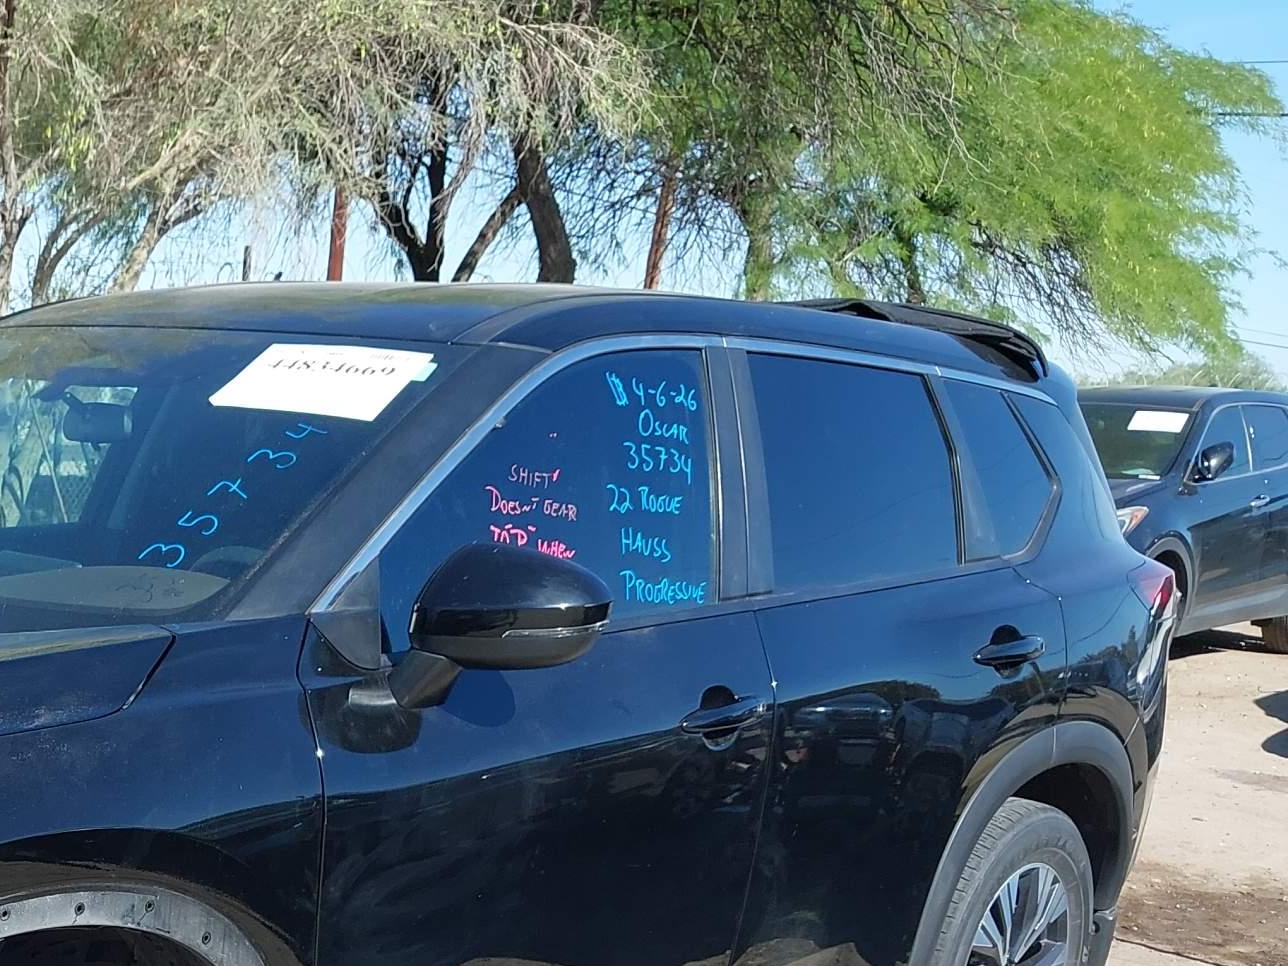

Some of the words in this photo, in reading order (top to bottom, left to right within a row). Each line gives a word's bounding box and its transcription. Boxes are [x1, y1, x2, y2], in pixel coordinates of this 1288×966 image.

[638, 409, 689, 445] OSCAR
[623, 441, 692, 485] 35734
[543, 499, 577, 522] GEAR
[606, 484, 632, 513] 22
[638, 486, 684, 514] ROGUE
[619, 570, 707, 604] PROGRESSIVE
